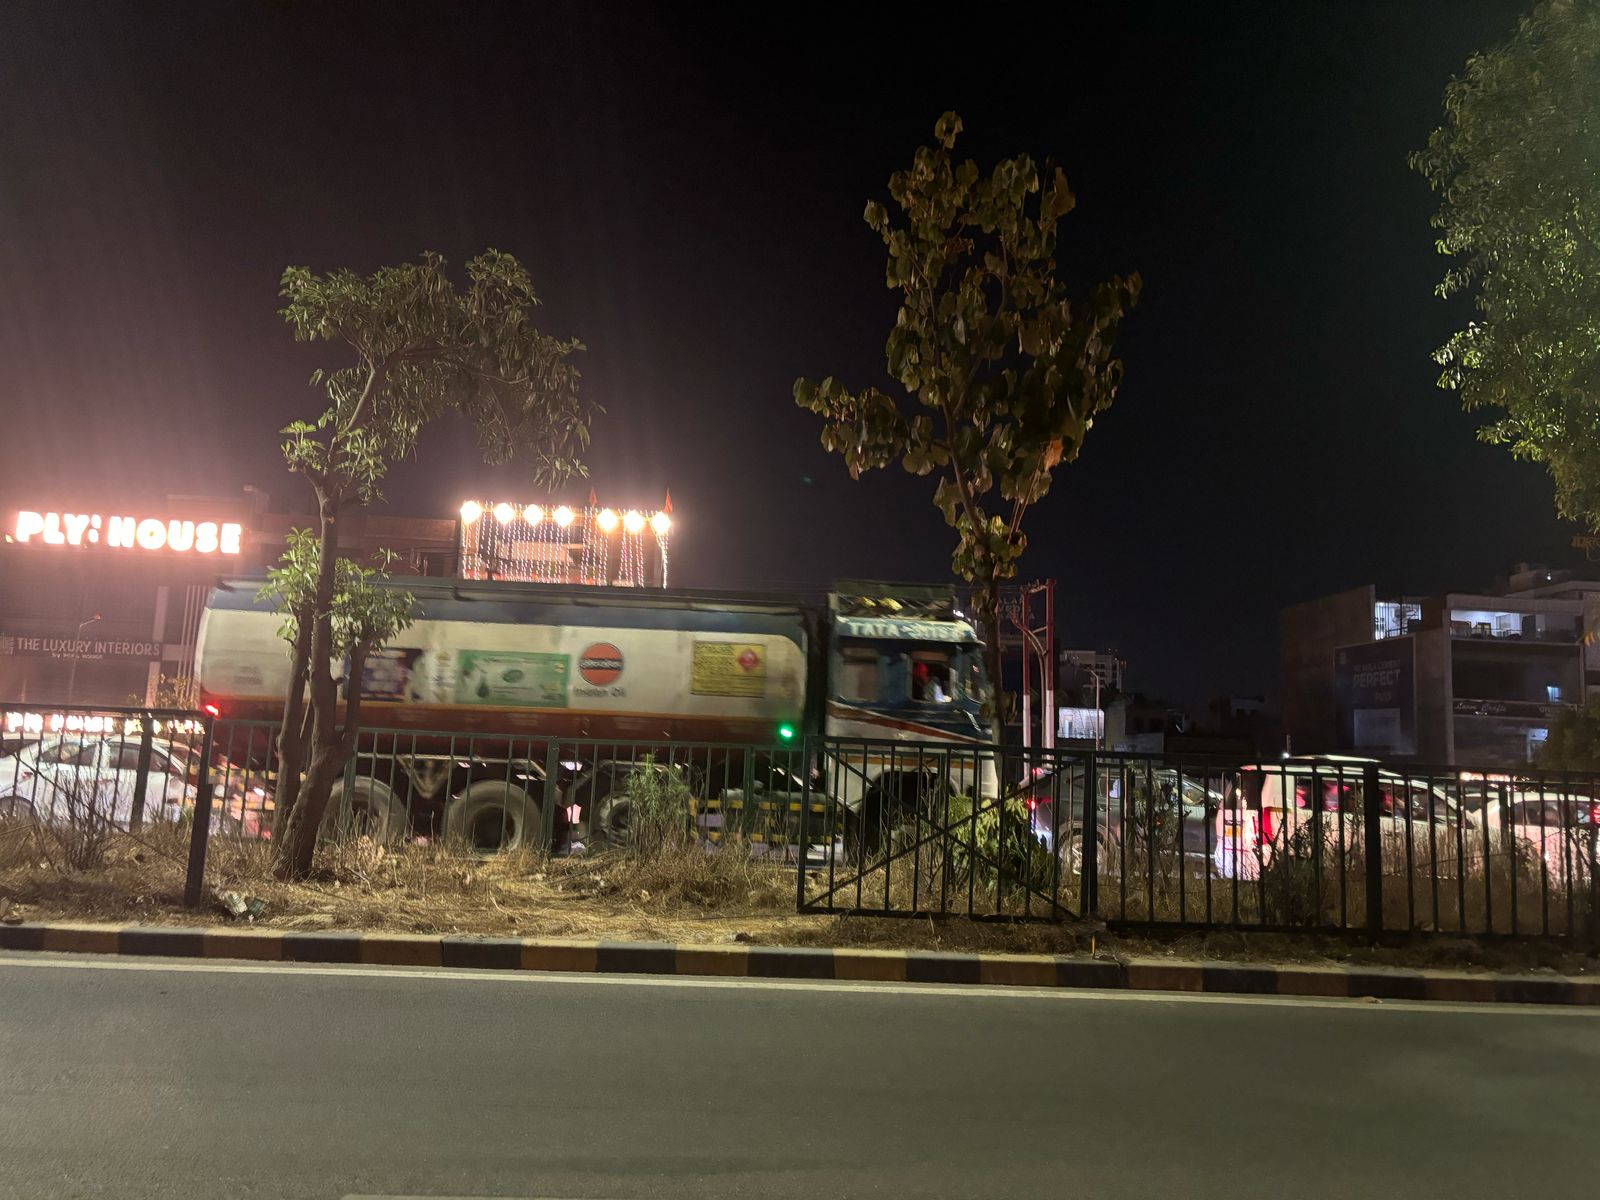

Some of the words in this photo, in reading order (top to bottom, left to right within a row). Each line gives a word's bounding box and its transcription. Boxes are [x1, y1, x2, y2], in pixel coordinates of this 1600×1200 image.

[107, 516, 242, 554] HOUSE
[850, 622, 899, 638] TATA
[17, 637, 40, 651] THE
[43, 638, 92, 653] LUXURY
[94, 641, 160, 656] INTERIORS
[1353, 669, 1401, 689] PERFECT
